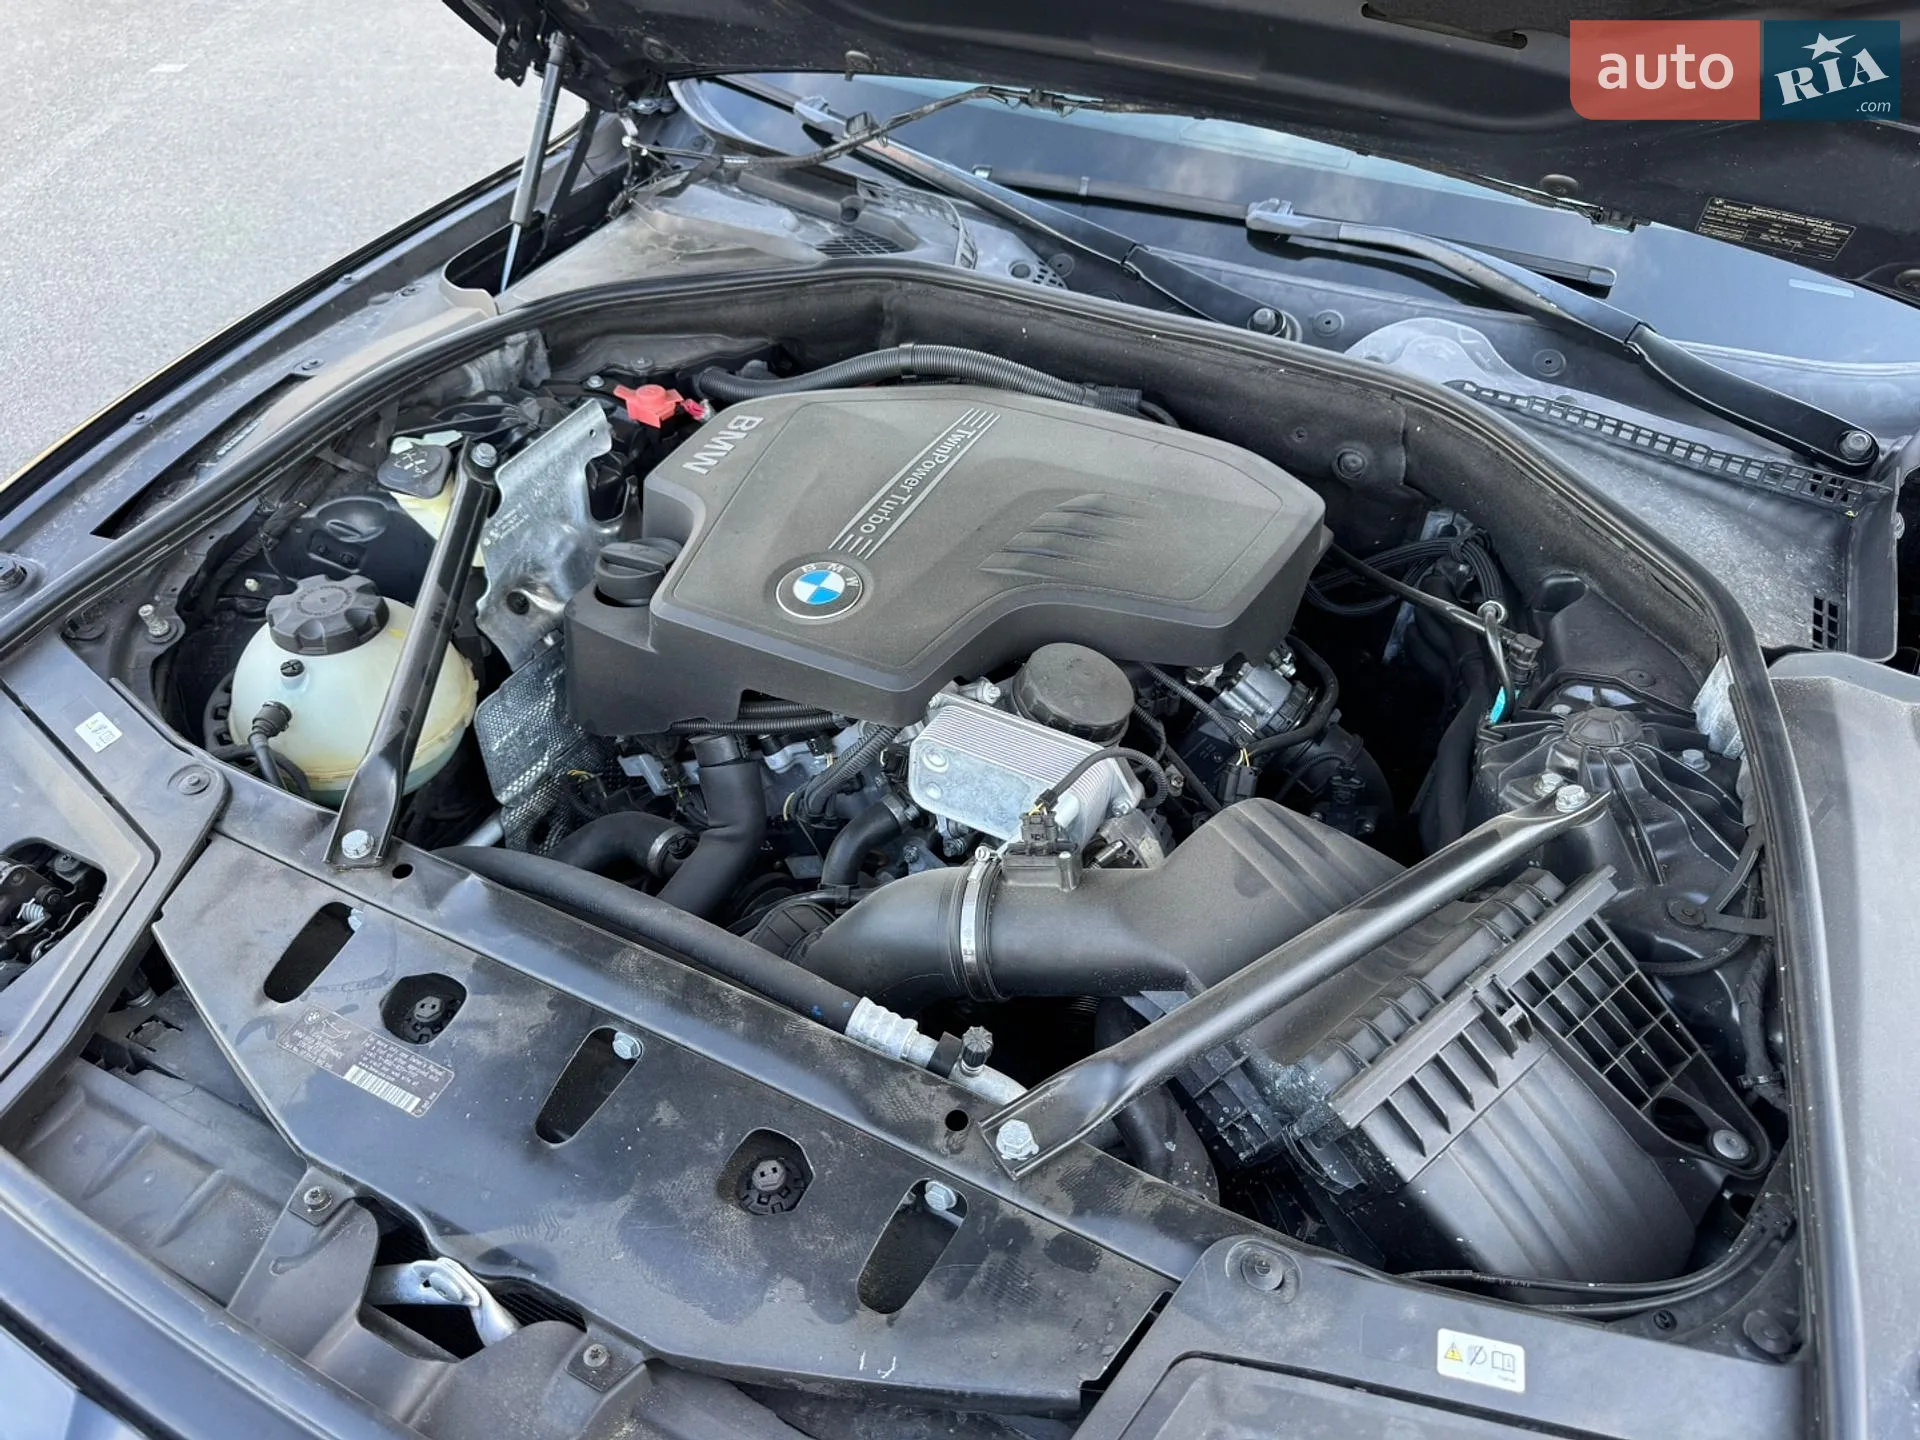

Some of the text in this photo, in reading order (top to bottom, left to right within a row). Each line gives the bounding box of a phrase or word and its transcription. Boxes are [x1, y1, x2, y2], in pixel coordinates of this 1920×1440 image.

[682, 415, 764, 475] BMW
[859, 428, 977, 534] TwinPower Turbo
[800, 562, 860, 588] BMW
